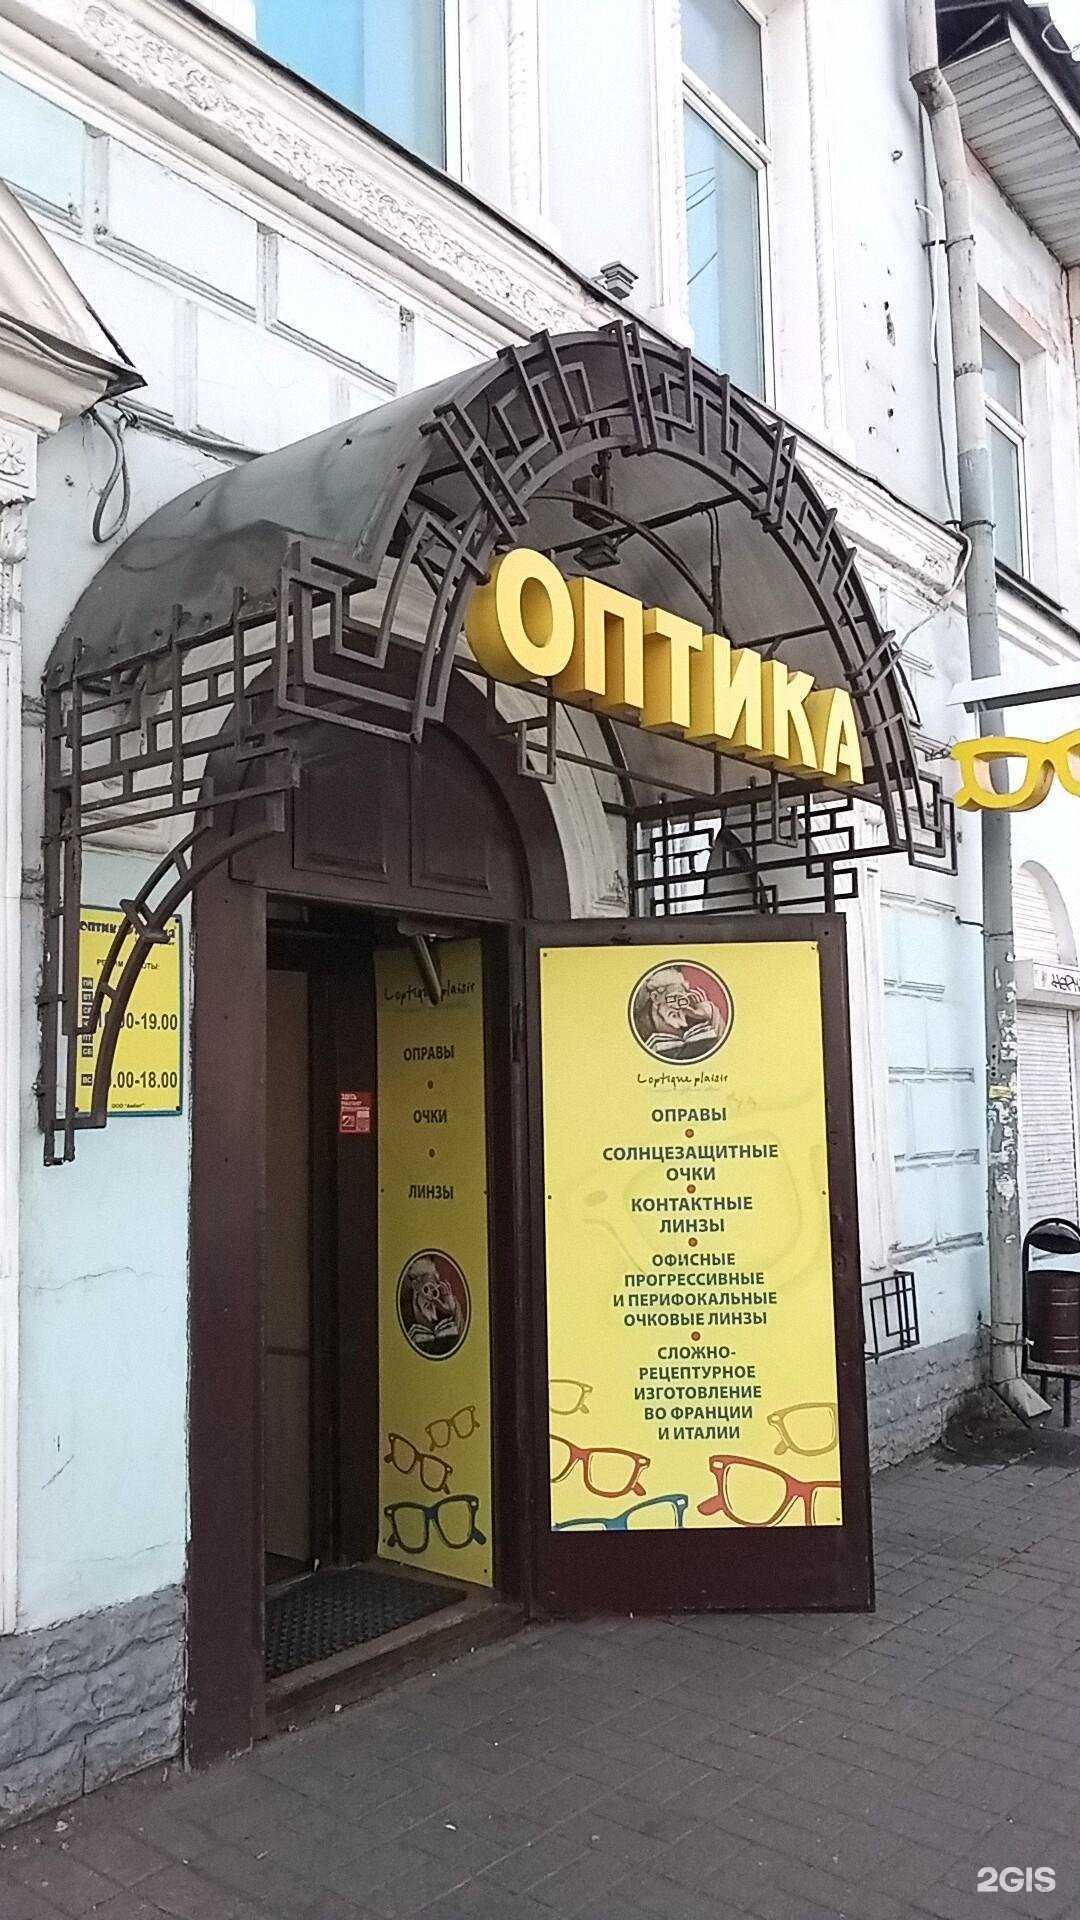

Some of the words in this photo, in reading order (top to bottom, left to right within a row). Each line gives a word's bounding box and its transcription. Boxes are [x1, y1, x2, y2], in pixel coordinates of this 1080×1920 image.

[469, 547, 864, 785] ОПТИКА
[403, 1045, 455, 1061] ОПРАВЫ
[413, 1109, 448, 1124] ОЧКИ
[651, 1107, 727, 1123] ОПРАВЫ
[602, 1144, 779, 1163] СОЛНЦЕЗАЩИТНЫЕ
[666, 1167, 716, 1182] ОЧКИ
[408, 1184, 454, 1200] ЛИНЗЫ
[631, 1196, 753, 1212] КОНТАКТНЫЕ
[659, 1218, 725, 1233] ЛИНЗЫ
[652, 1252, 736, 1267] ОФИСНЫЕ
[624, 1272, 765, 1287] ПРОГРЕССИВНЫЕ
[613, 1294, 625, 1307] И
[628, 1291, 777, 1307] ПЕРИФОКАЛЬНЫЕ
[623, 1312, 705, 1327] ОЧКОВЫЕ
[707, 1311, 767, 1326] ЛИНЗЫ
[657, 1345, 736, 1360] СЛОЖНО-
[639, 1365, 756, 1382] РЕЦЕПТУРНОЕ
[634, 1385, 762, 1401] ИЗГОТОВЛЕНИЕ
[644, 1407, 667, 1421] ВО
[670, 1405, 753, 1422] ФРАНЦИИ
[657, 1427, 670, 1441] И
[673, 1426, 740, 1440] ИТАЛИИ
